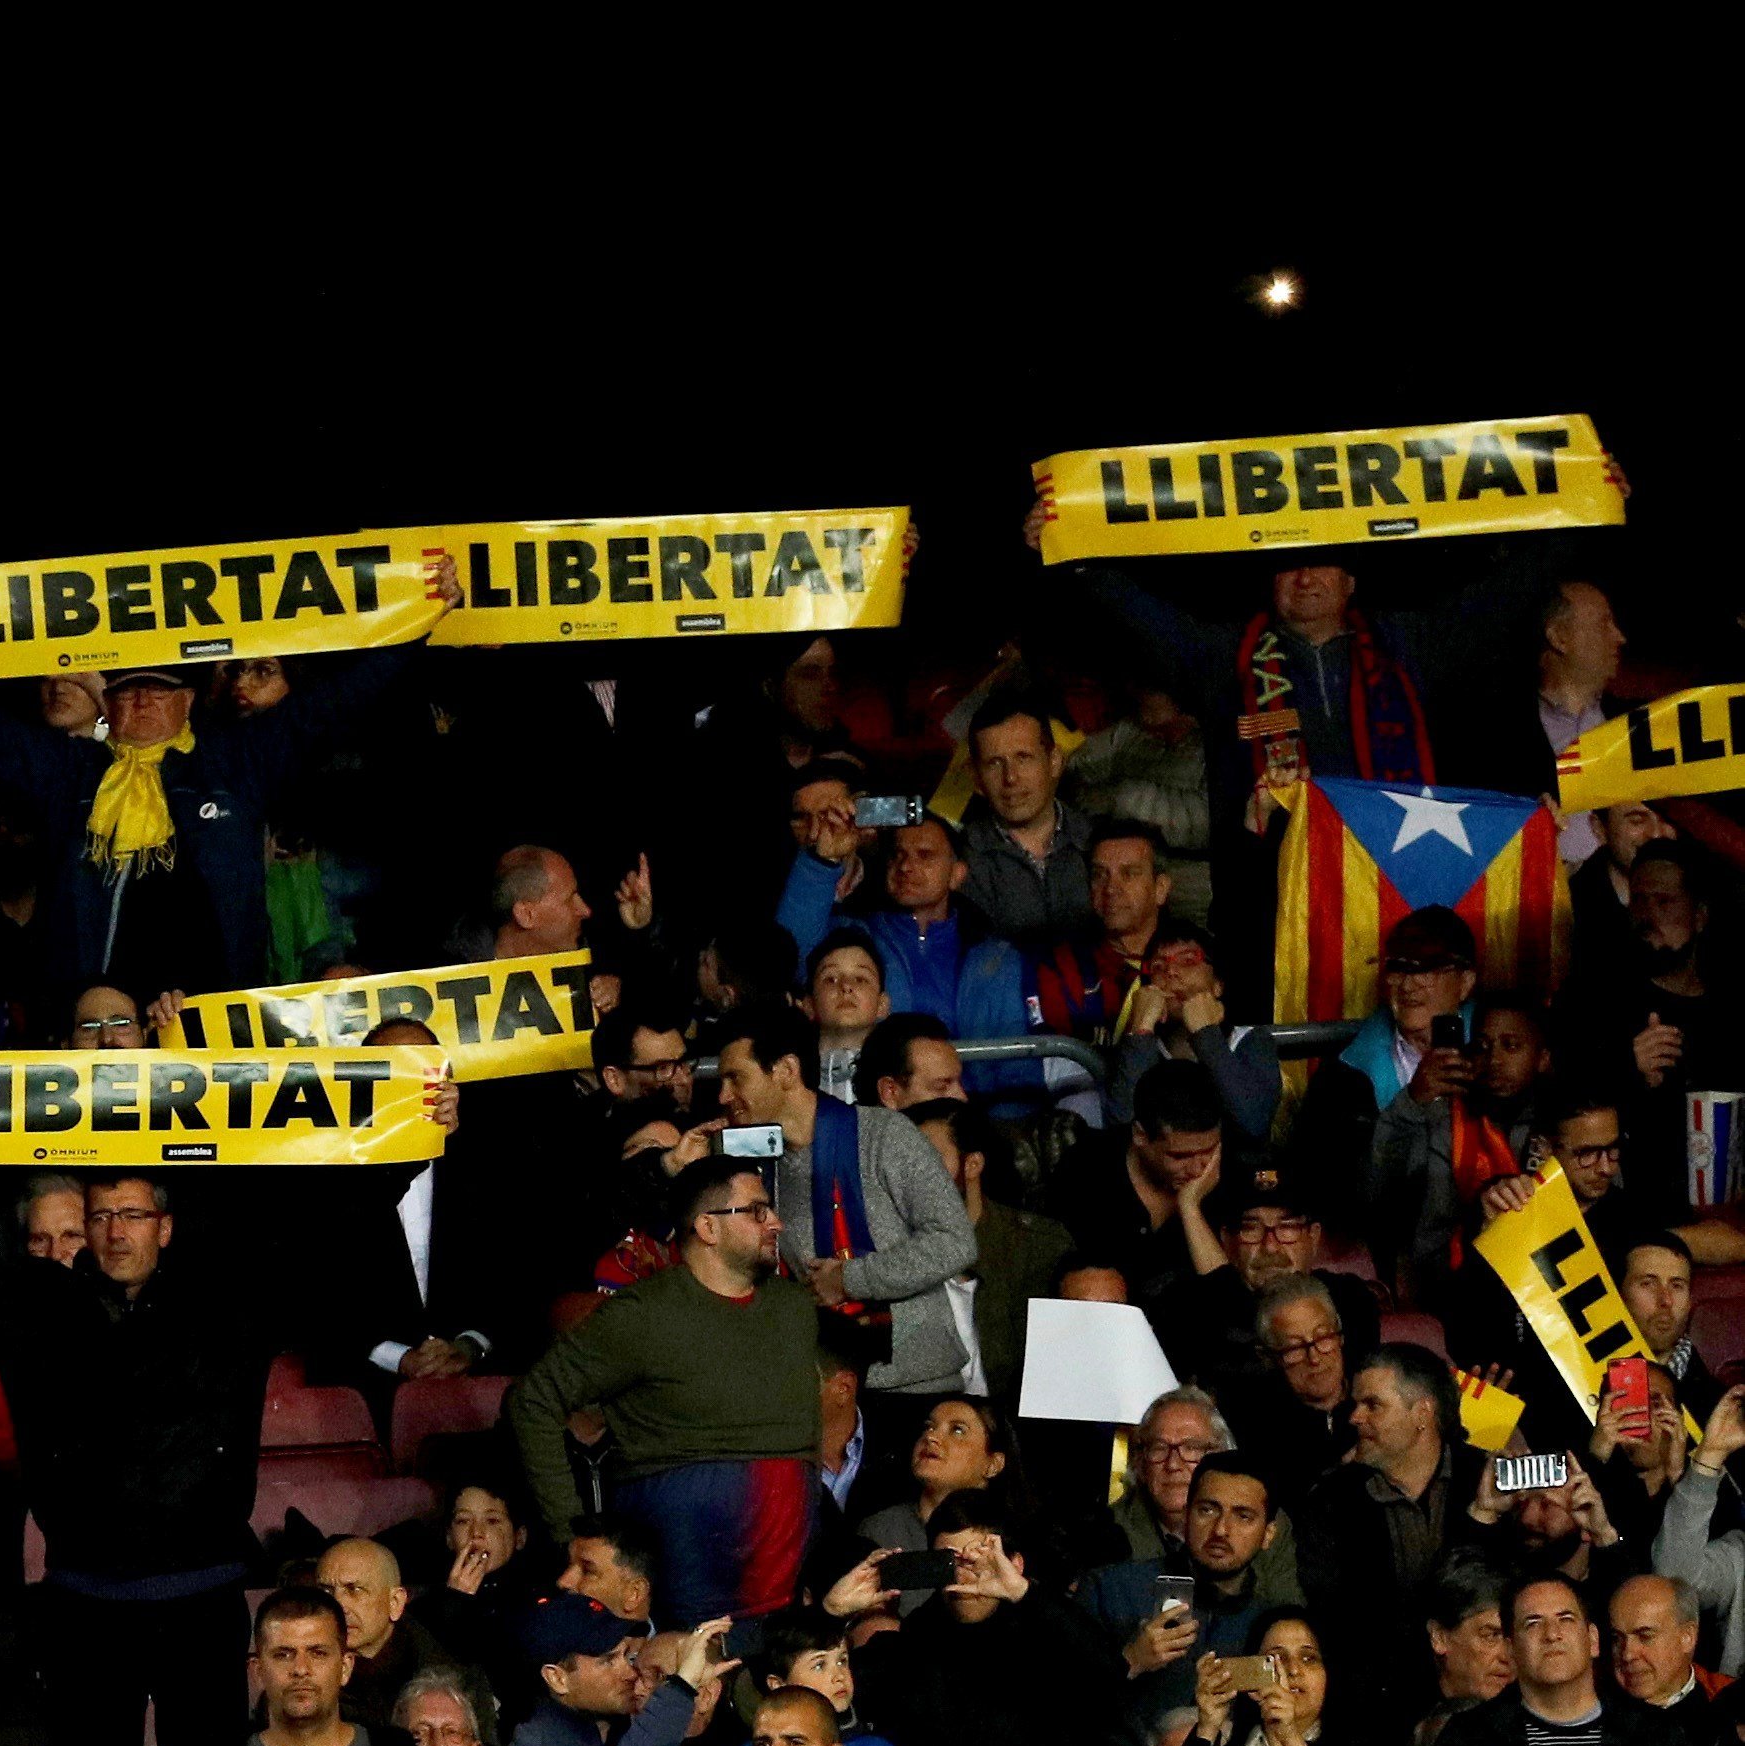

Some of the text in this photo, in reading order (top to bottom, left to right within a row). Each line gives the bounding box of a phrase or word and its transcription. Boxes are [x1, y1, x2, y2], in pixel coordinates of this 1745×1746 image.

[1100, 429, 1569, 524] LLIBERTAT
[454, 530, 876, 609] LIBERTAT
[168, 1146, 212, 1157] assemblea
